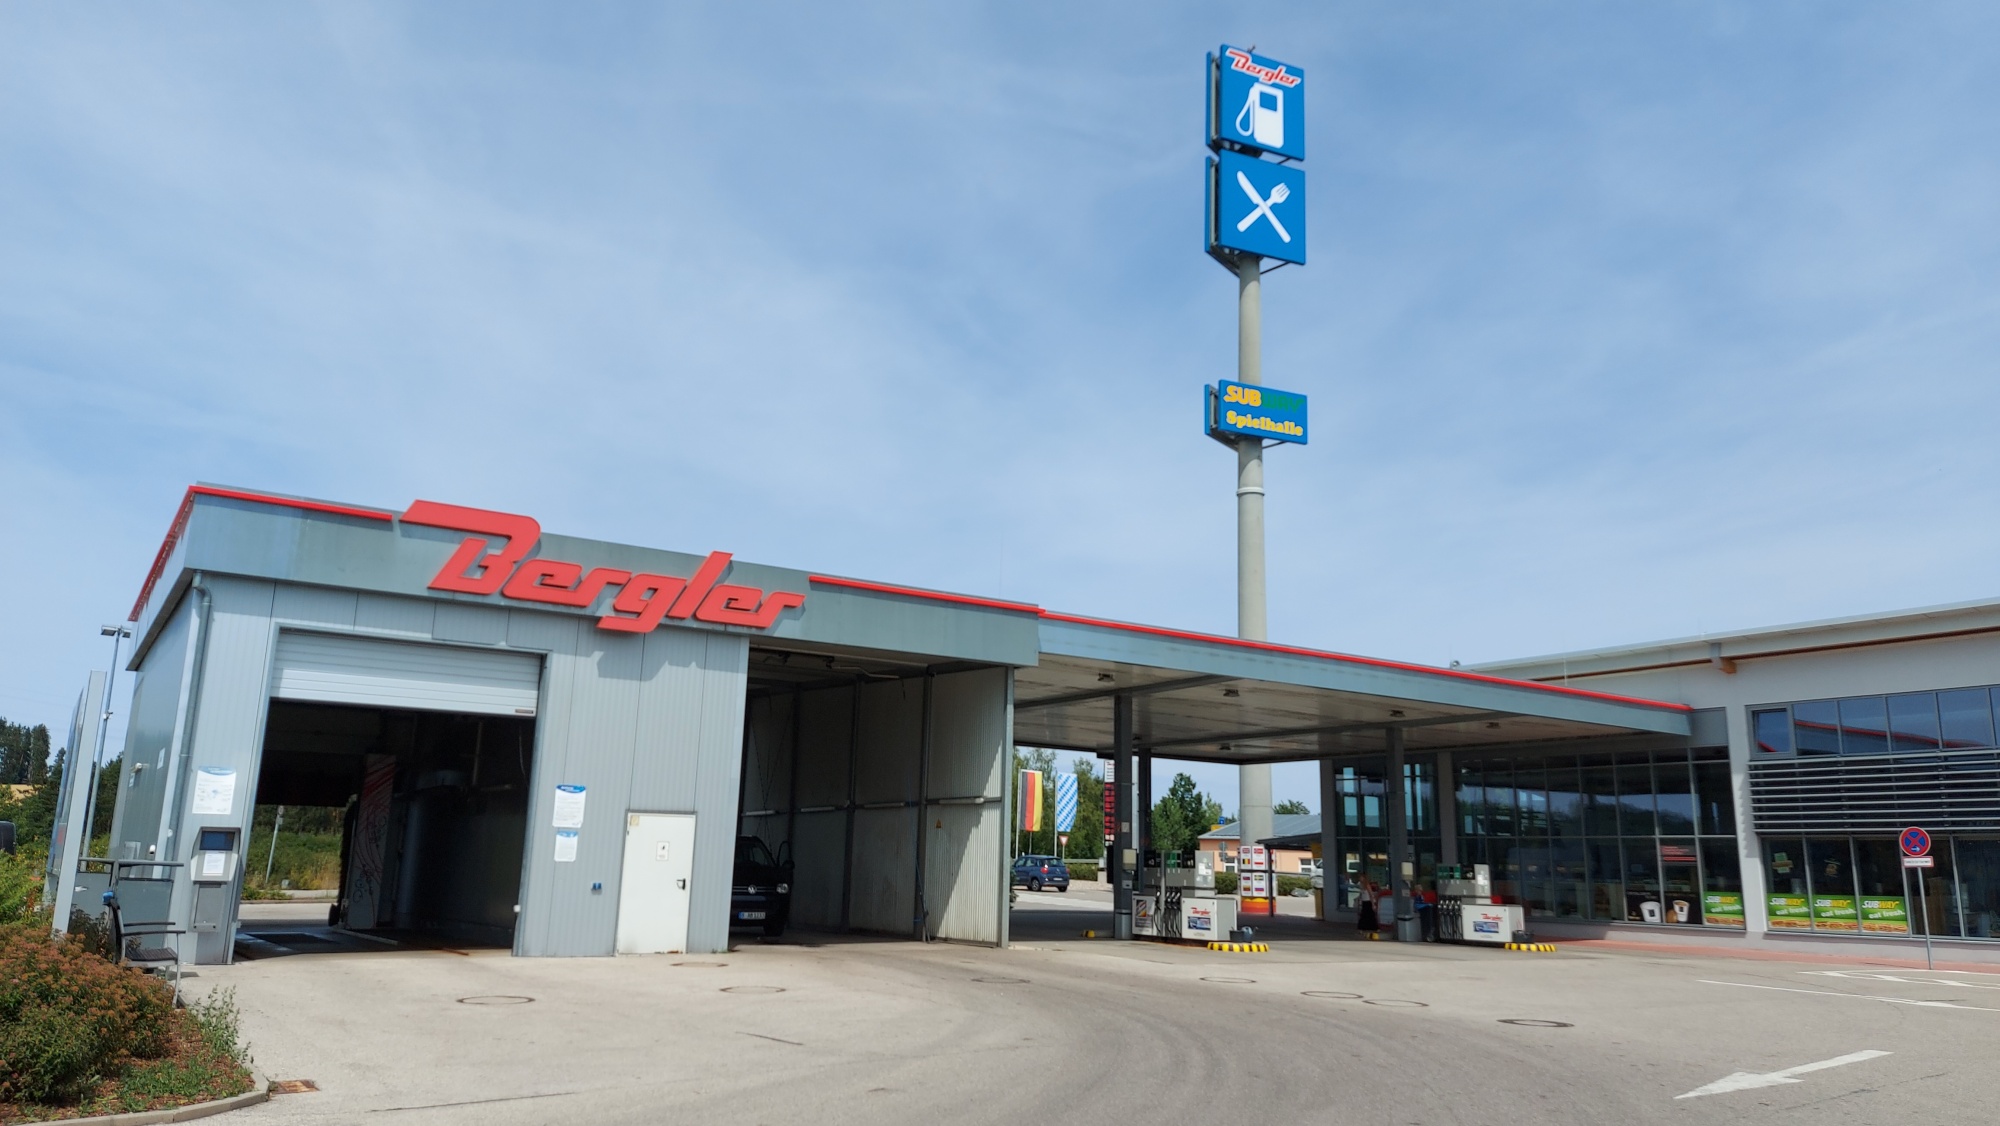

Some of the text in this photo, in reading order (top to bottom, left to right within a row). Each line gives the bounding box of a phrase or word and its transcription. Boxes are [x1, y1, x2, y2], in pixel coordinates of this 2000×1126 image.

[1227, 48, 1300, 87] Bergler
[1224, 385, 1304, 412] SUBWAY
[1226, 410, 1303, 436] Spielhalle
[399, 500, 806, 633] Bergler
[1705, 896, 1738, 904] SUBWAY
[1769, 898, 1805, 906] SUBWAY
[1814, 899, 1851, 908] SUBWAY
[1862, 900, 1899, 909] SUBWAY
